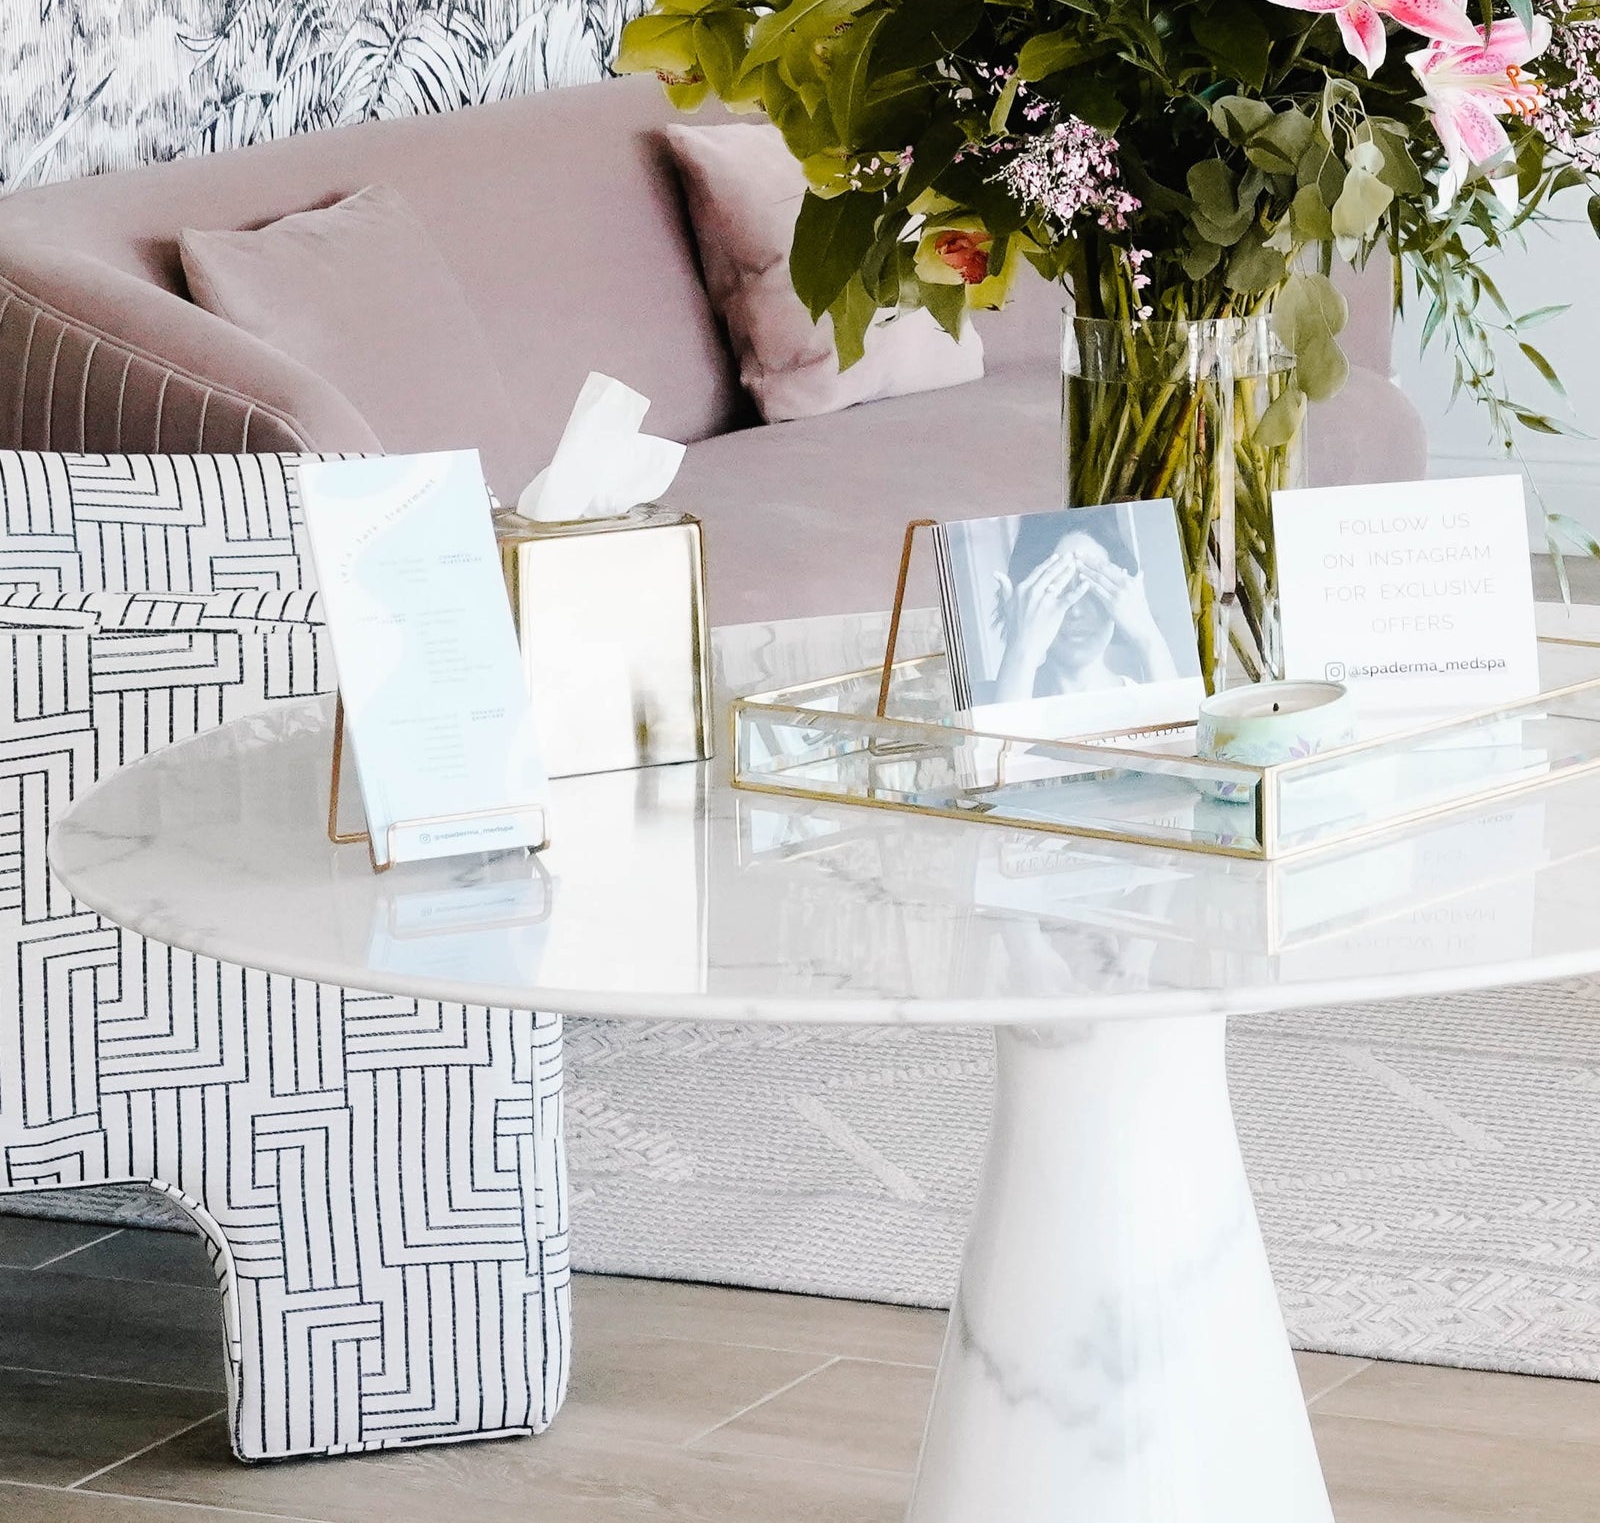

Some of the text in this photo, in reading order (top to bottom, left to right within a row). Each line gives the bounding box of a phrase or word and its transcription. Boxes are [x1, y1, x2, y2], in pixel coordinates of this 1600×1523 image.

[1338, 513, 1471, 536] FOLLOW US
[1322, 545, 1491, 569] ON INSTAGRAM
[1324, 578, 1496, 603] FOR EXCLUSIVE
[1371, 614, 1455, 634] OFFERS
[1348, 656, 1506, 678] @spaderma_medspa
